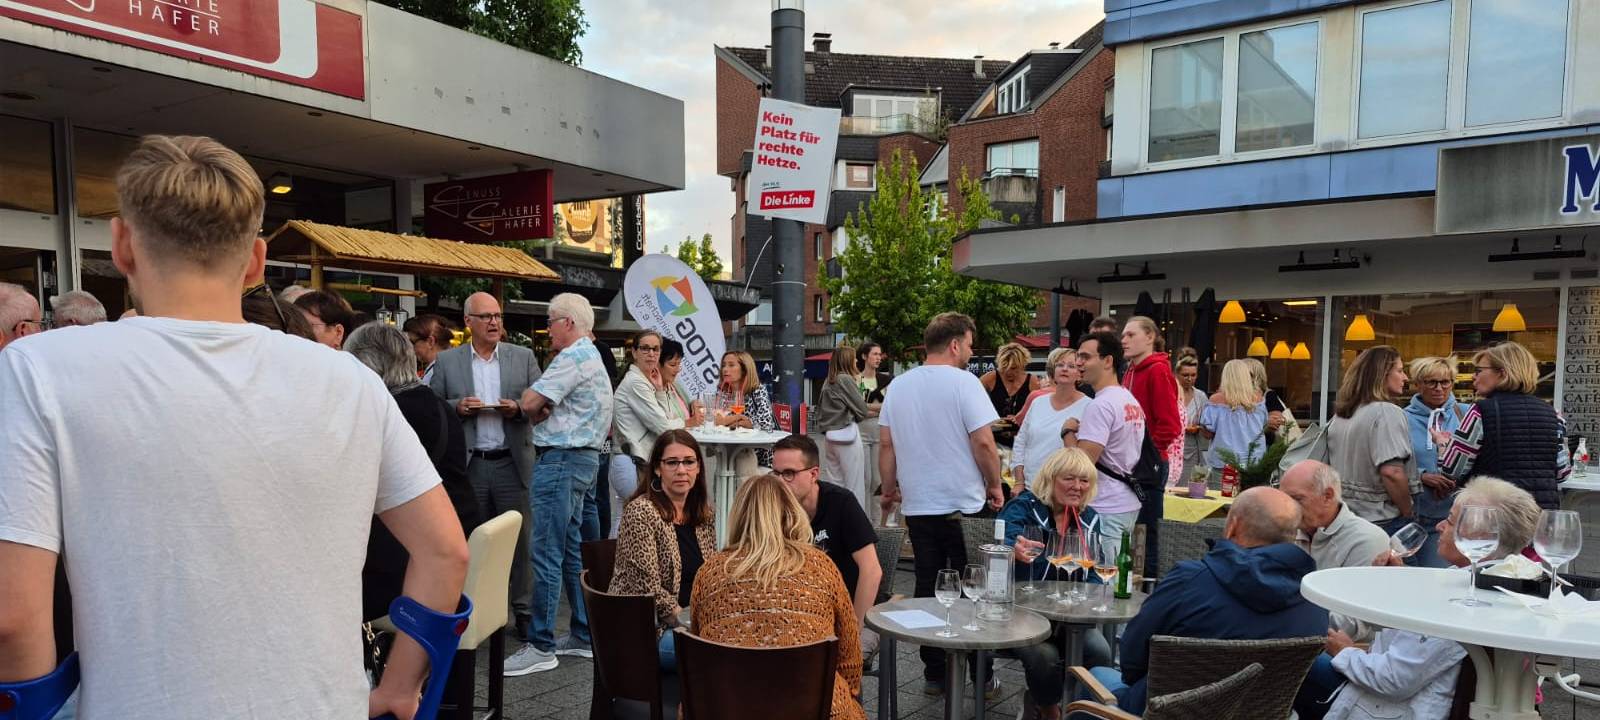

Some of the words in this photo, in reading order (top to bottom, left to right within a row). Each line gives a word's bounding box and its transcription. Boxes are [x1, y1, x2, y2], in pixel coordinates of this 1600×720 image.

[129, 0, 219, 36] HAFER
[762, 111, 794, 126] Kein
[761, 126, 797, 141] Platz
[799, 131, 821, 144] für
[758, 142, 804, 157] rechte
[757, 154, 801, 170] Hetze.
[764, 196, 782, 207] Die
[782, 192, 811, 206] Linke
[504, 217, 541, 229] HAFER
